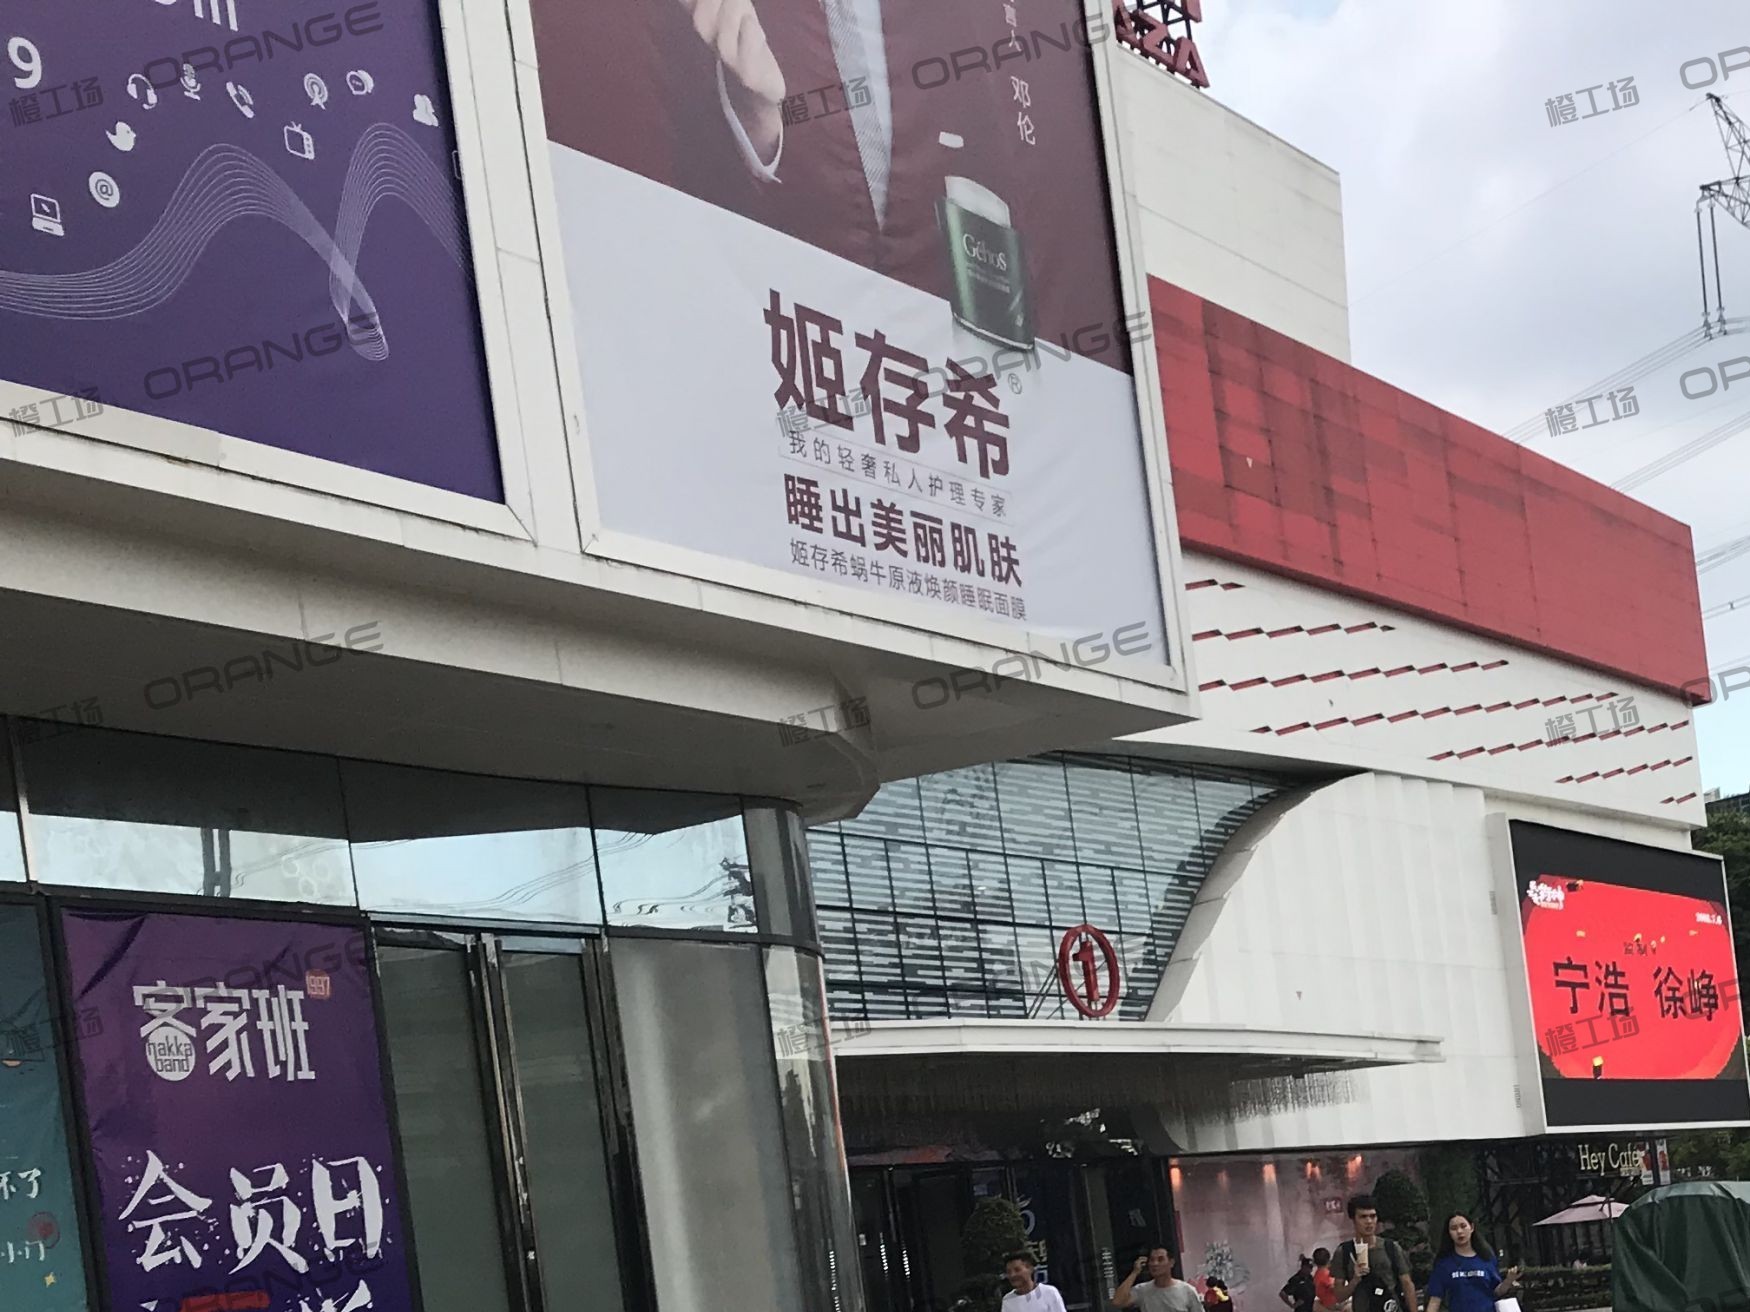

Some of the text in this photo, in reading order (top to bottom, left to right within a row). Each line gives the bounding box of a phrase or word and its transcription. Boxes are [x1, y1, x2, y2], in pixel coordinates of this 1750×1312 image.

[1010, 75, 1036, 146] 邓伦
[762, 288, 1010, 480] 姬存希
[789, 429, 1007, 518] 我的轻奢私人护理专家
[784, 472, 1023, 588] 睡出美丽肌肤
[132, 979, 316, 1082] 客家班
[1552, 956, 1631, 1018] 宁浩
[1652, 965, 1720, 1022] 徐峥
[1578, 1143, 1606, 1176] Hey
[118, 1149, 384, 1275] 会员日
